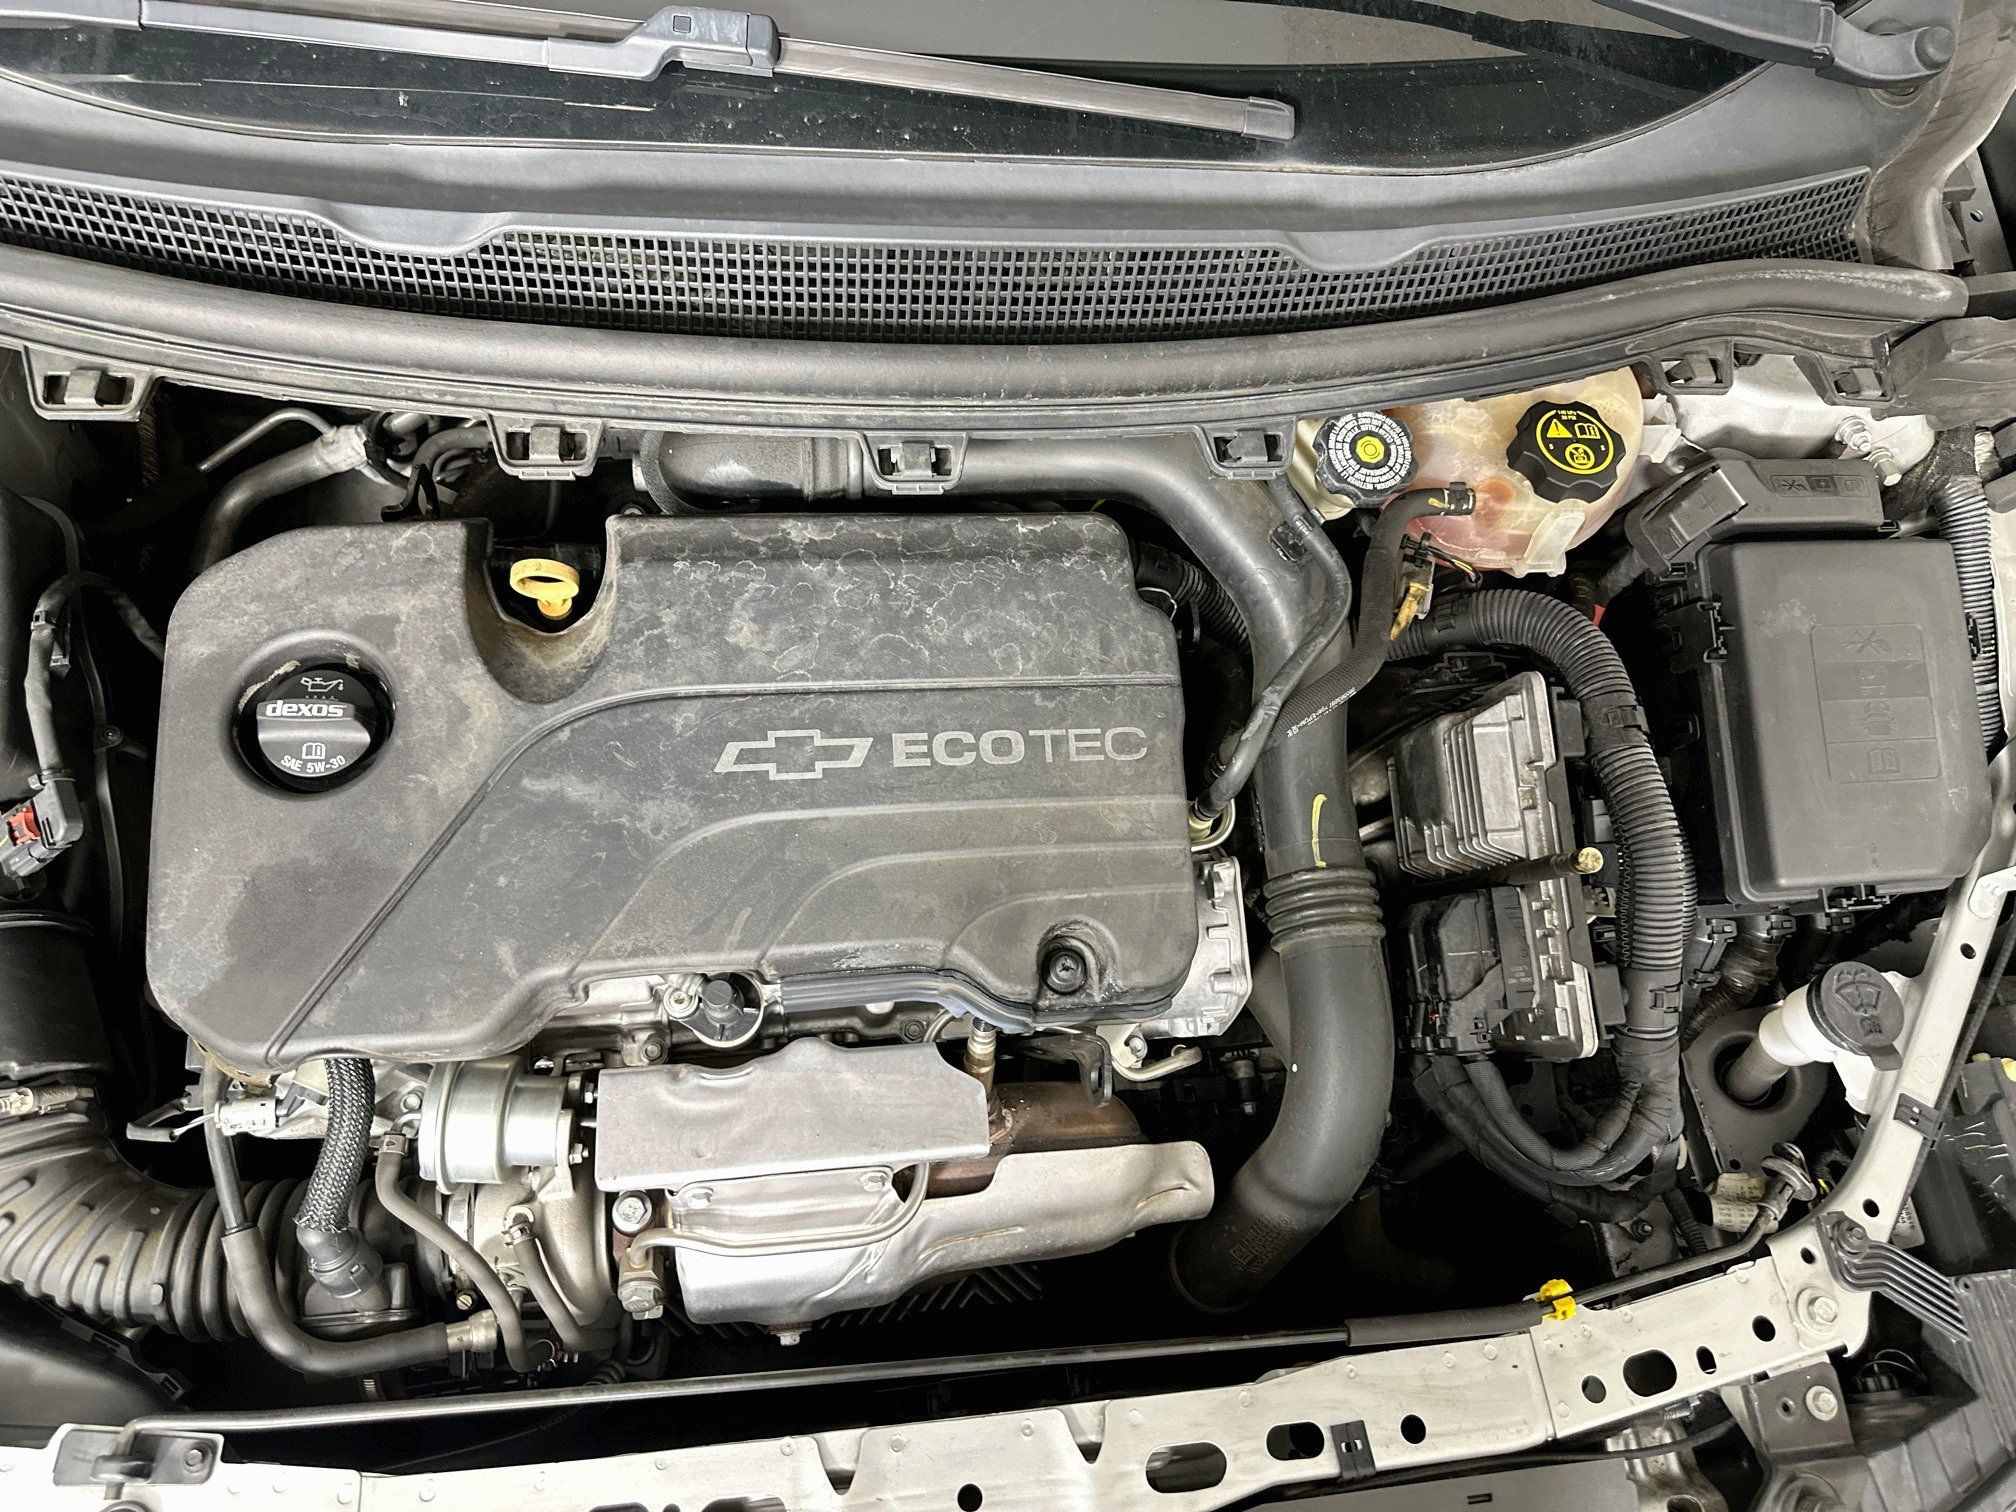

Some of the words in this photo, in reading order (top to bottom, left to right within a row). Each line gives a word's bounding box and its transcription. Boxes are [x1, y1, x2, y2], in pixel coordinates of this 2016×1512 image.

[266, 700, 344, 717] dexos
[892, 726, 1148, 768] ECOTEC
[280, 754, 303, 772] SAE
[306, 754, 346, 773] 5W-30
